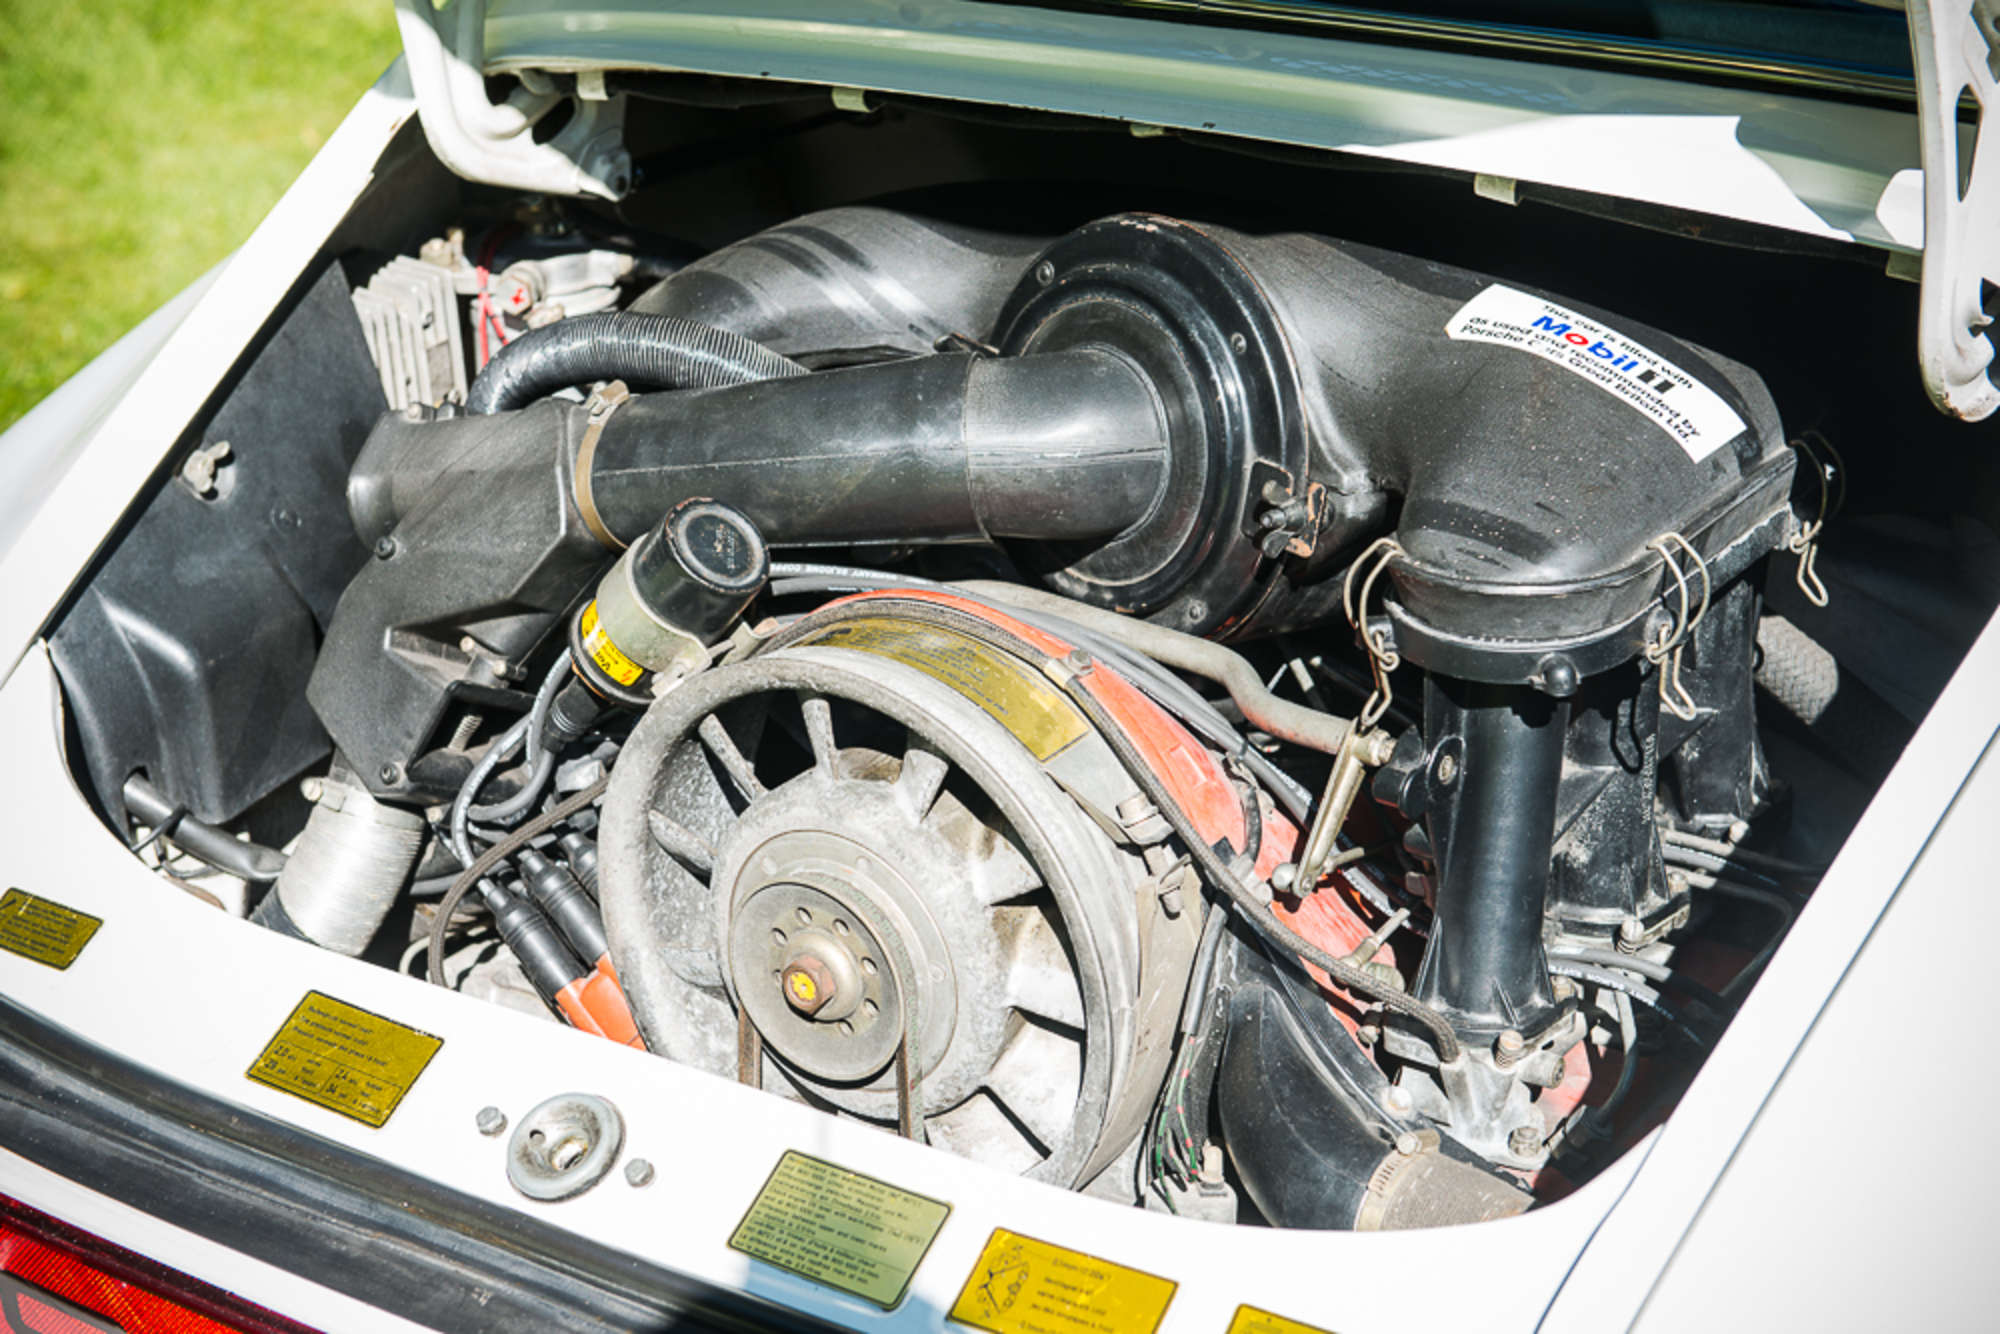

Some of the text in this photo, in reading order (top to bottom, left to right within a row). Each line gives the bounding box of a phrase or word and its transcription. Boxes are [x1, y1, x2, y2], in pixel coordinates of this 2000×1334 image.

[1460, 323, 1524, 343] Porsche
[1569, 357, 1613, 384] Great
[1615, 382, 1664, 417] Britain
[1469, 317, 1701, 437] as used and recommended by
[1531, 315, 1639, 373] Mobil
[1575, 320, 1601, 333] car
[1661, 365, 1693, 389] with
